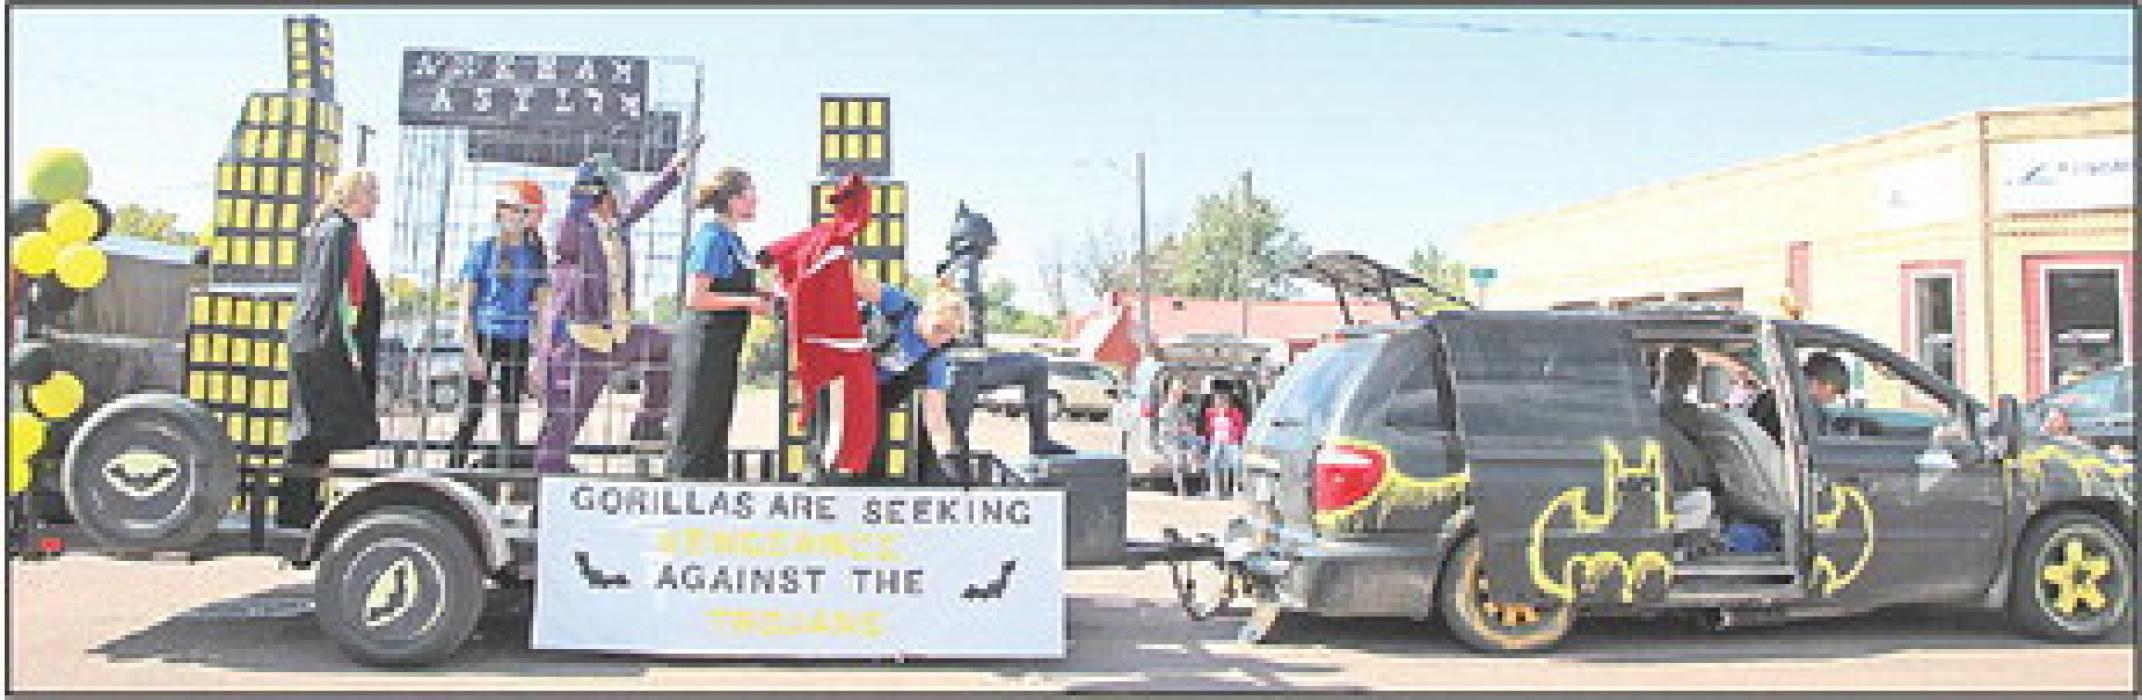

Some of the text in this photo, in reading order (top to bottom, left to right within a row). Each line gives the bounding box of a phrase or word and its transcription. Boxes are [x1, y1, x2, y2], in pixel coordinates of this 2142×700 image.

[569, 485, 1032, 526] GORILLAS ARE SEEKING
[655, 528, 907, 561] VENGEANCE
[654, 563, 925, 595] AGAINST THE
[705, 608, 888, 637] TROJANS
